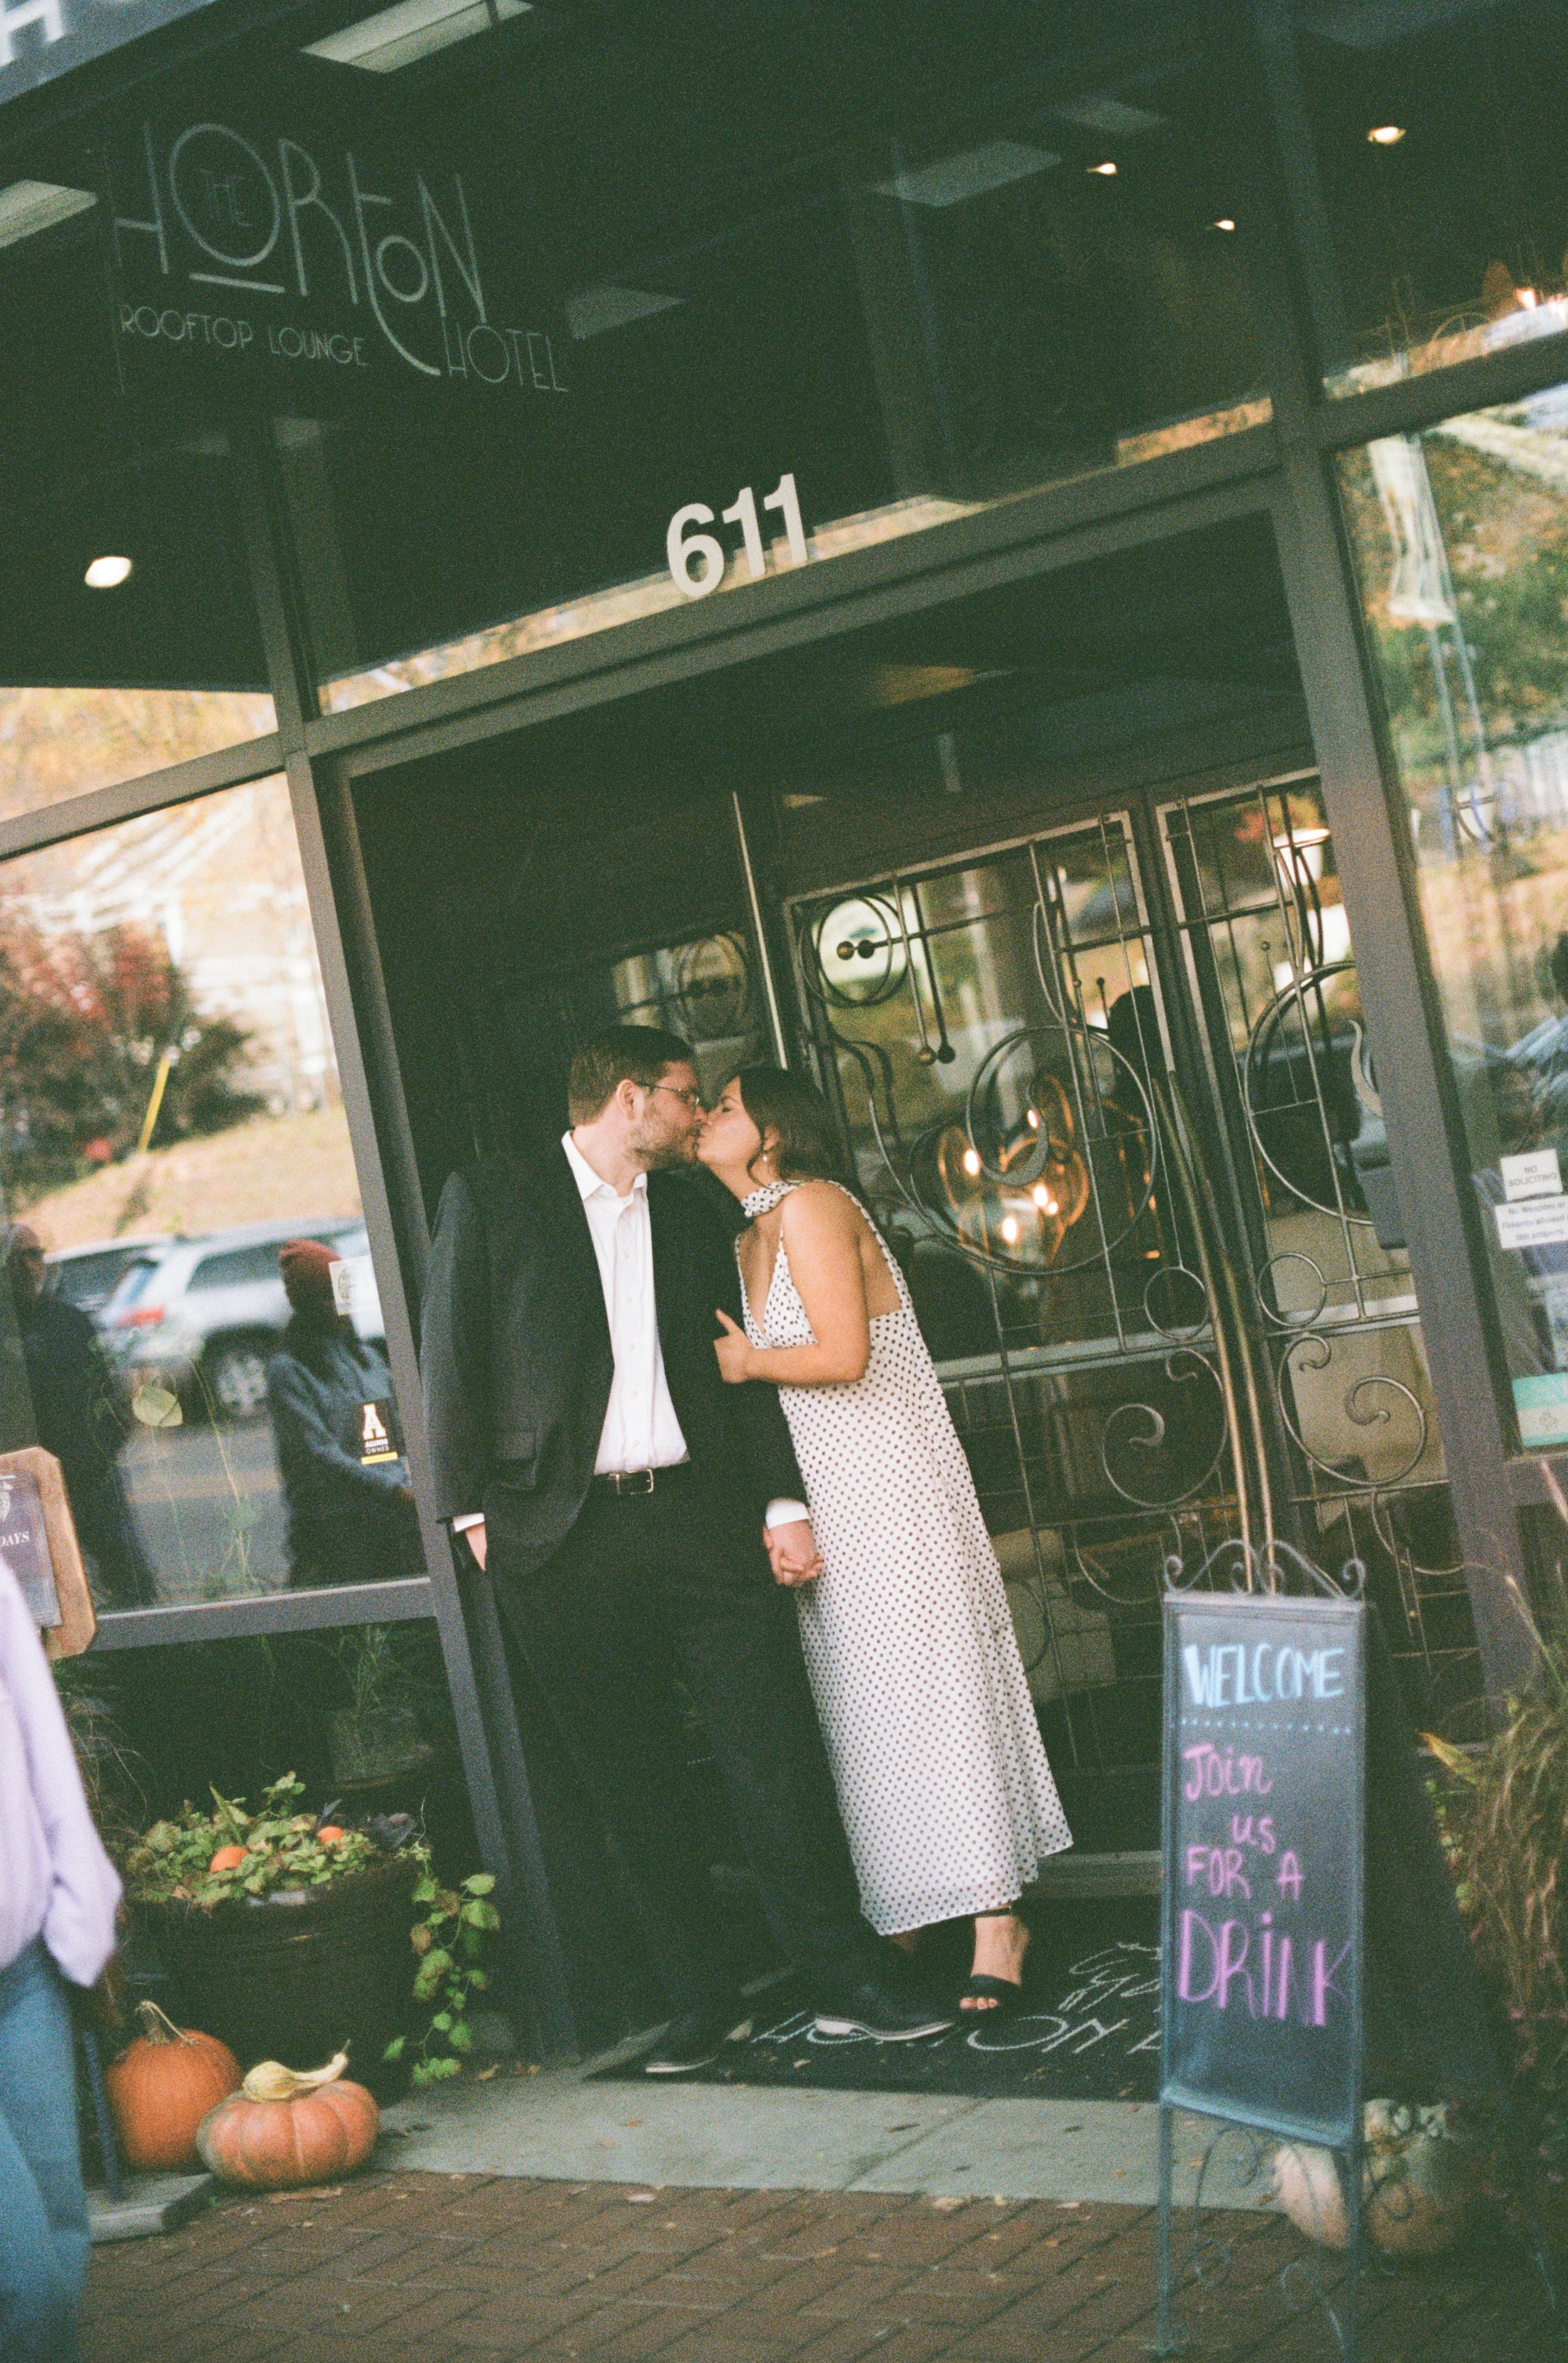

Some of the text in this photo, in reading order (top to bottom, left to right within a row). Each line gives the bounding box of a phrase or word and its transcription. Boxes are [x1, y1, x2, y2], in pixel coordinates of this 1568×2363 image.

[119, 304, 369, 368] ROOFTOP LOUNGE
[443, 319, 569, 393] HOTEL
[667, 473, 807, 597] 611
[1508, 1172, 1557, 1187] SOLICITING
[364, 1438, 389, 1448] ALUMNI
[366, 1445, 389, 1455] OWNED
[1182, 1641, 1345, 1708] WELCOME
[1185, 1845, 1305, 1901] FOR A
